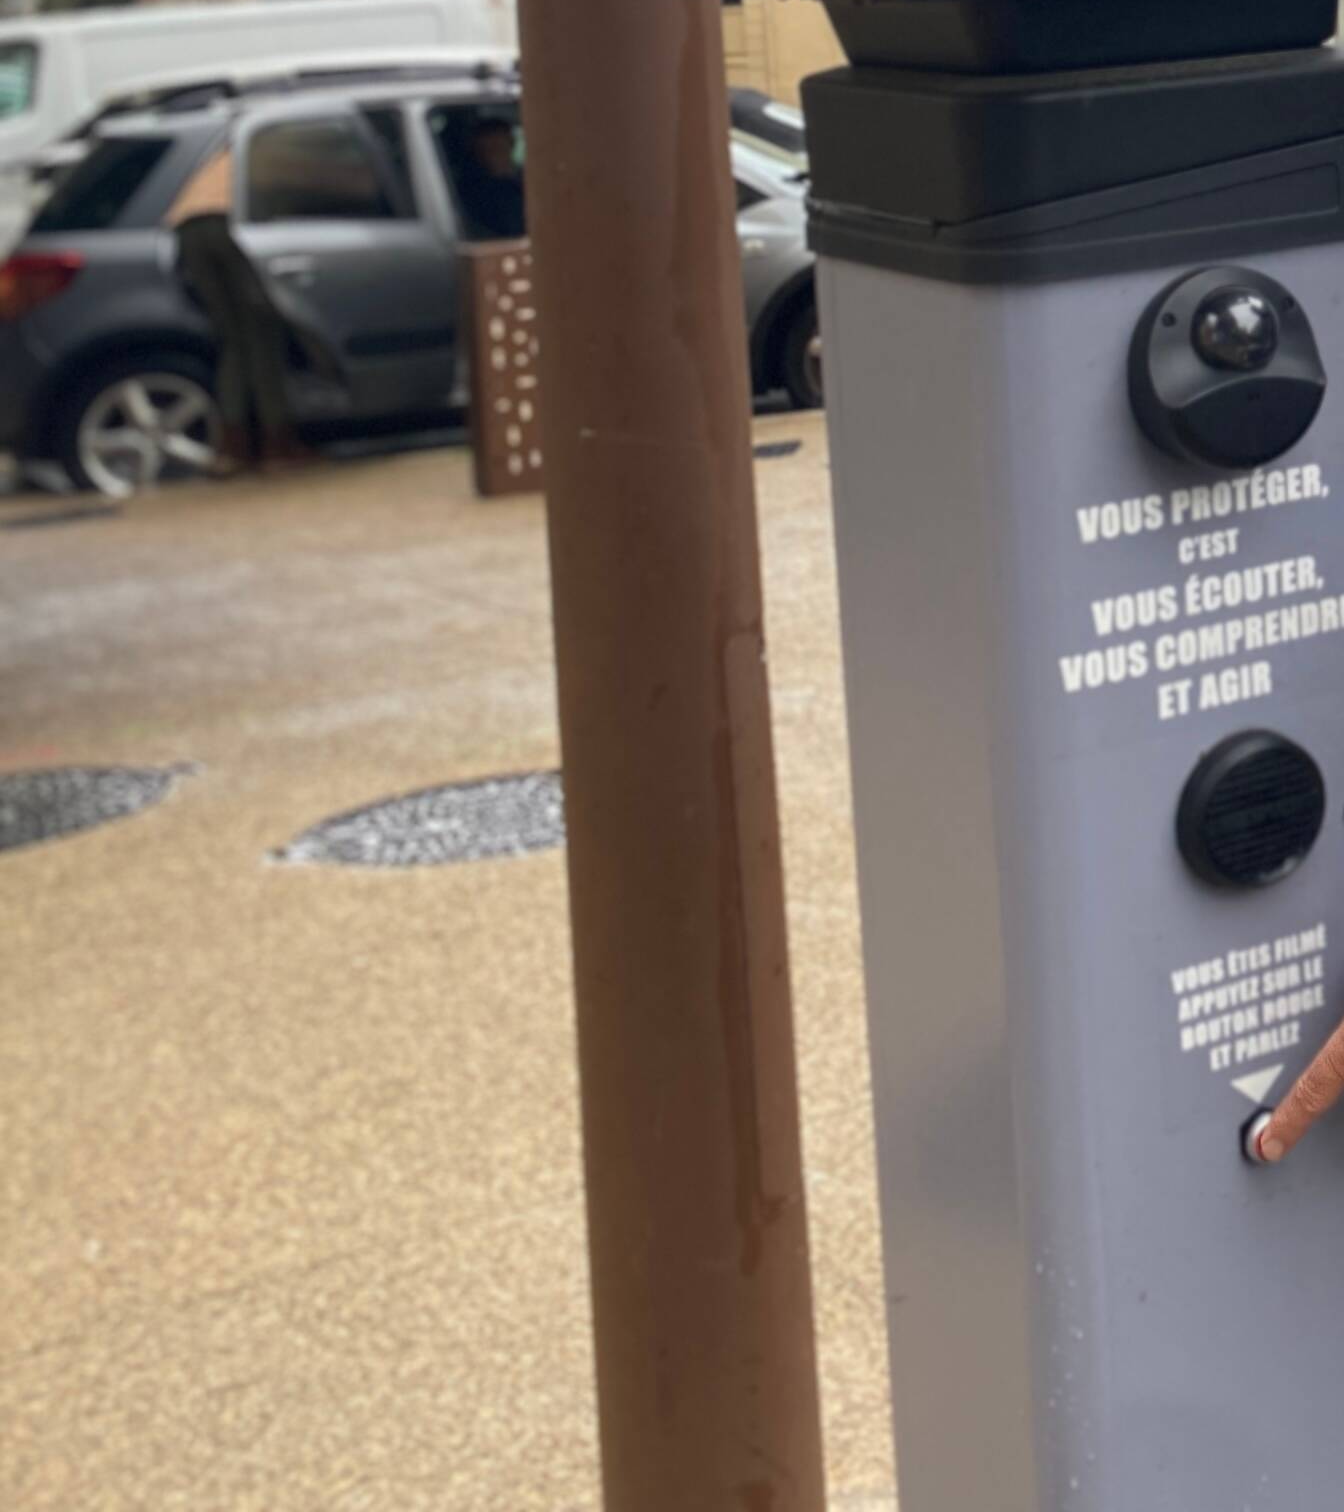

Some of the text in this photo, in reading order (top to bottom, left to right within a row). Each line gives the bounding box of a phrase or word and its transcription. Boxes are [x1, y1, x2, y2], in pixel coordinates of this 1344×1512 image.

[1077, 464, 1329, 543] VOUS PROTÉGER,
[1178, 528, 1239, 564] C'EST
[1092, 555, 1324, 637] VOUS ÉCOUTER,
[1060, 643, 1148, 692] VOUS
[1158, 660, 1272, 719] ET AGIR
[1171, 957, 1224, 994] VOUS
[1274, 922, 1325, 963] FILMÉ
[1178, 955, 1323, 1023] APPUYEZ SUR LE
[1180, 983, 1324, 1051] BOUTON ROUGE
[1210, 1020, 1299, 1072] ET PARLEZ
